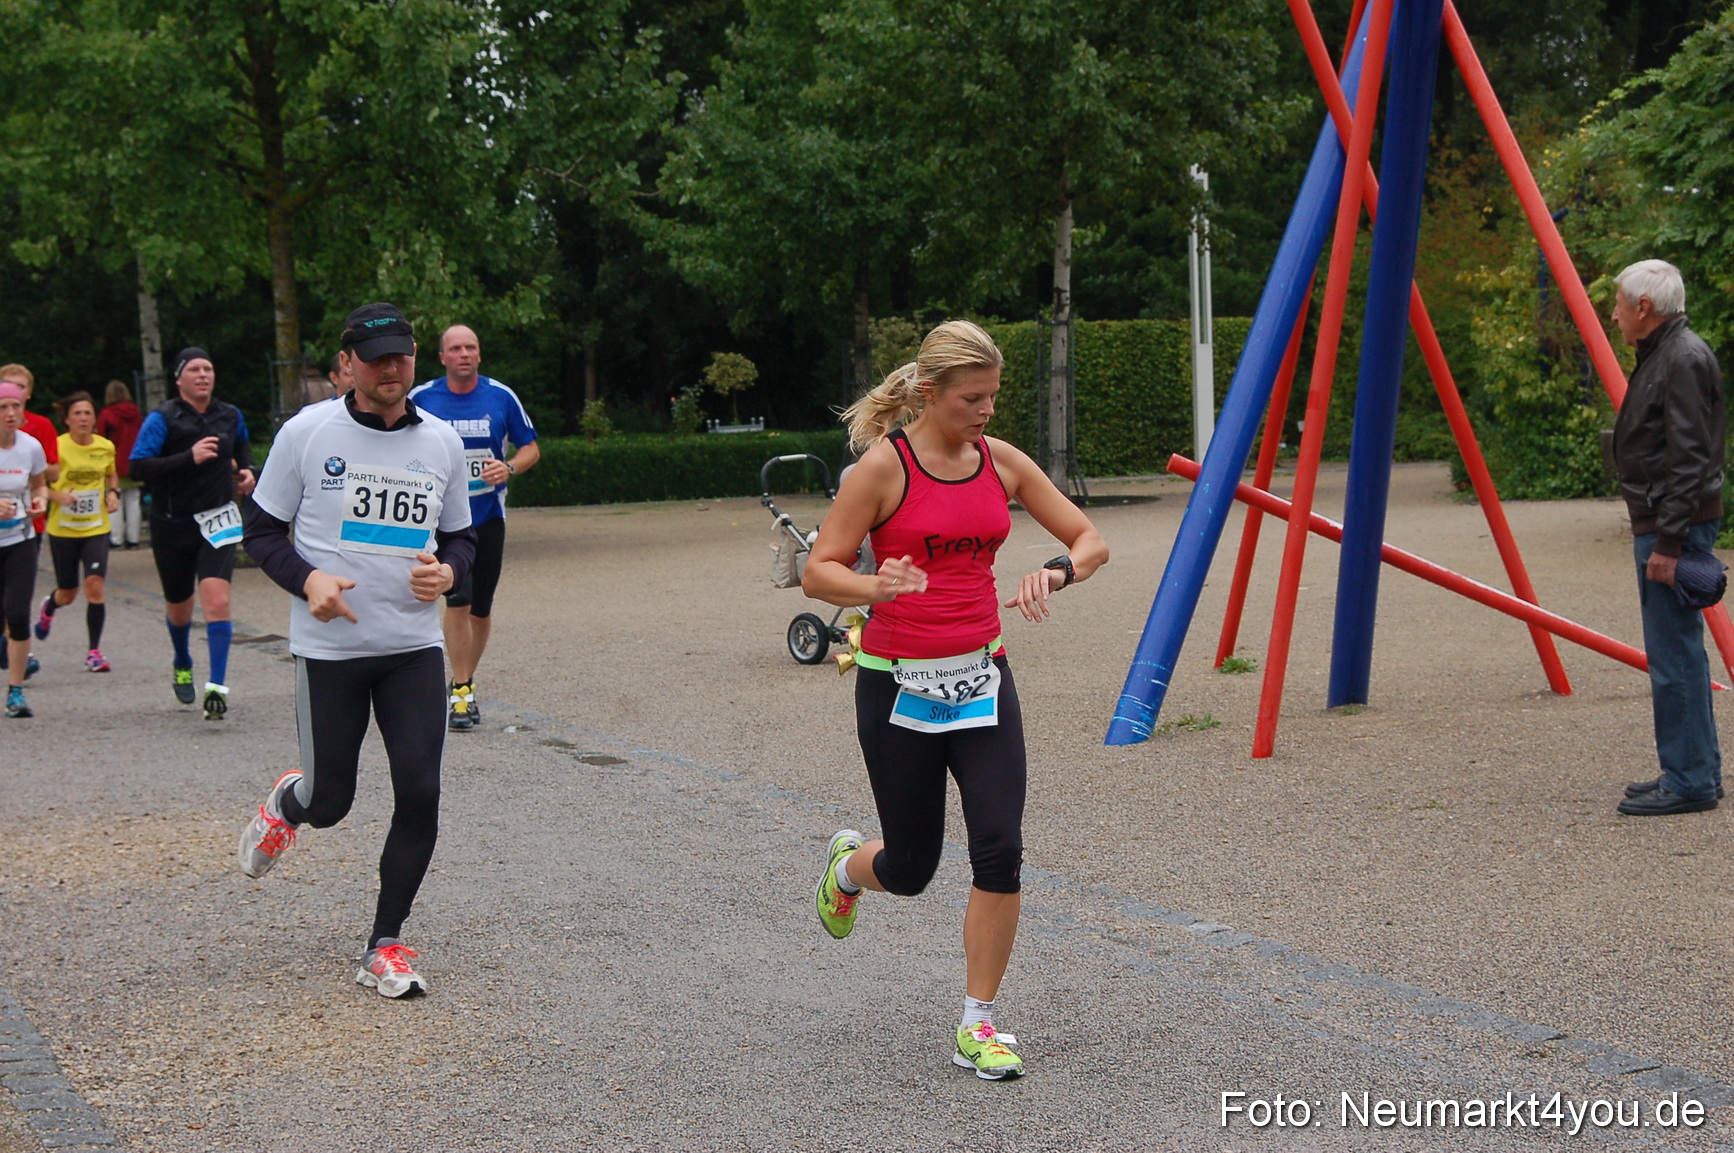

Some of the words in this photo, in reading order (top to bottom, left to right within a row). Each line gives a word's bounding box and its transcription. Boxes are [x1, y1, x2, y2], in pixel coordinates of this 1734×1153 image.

[443, 419, 490, 431] UBER
[320, 478, 345, 486] PART
[347, 472, 379, 484] PARTL
[381, 476, 422, 489] Neumarkt
[352, 486, 428, 525] 3165
[896, 670, 933, 682] PARTL
[935, 663, 980, 679] Neumarkt
[918, 673, 991, 704] 162
[929, 706, 961, 721] Silke
